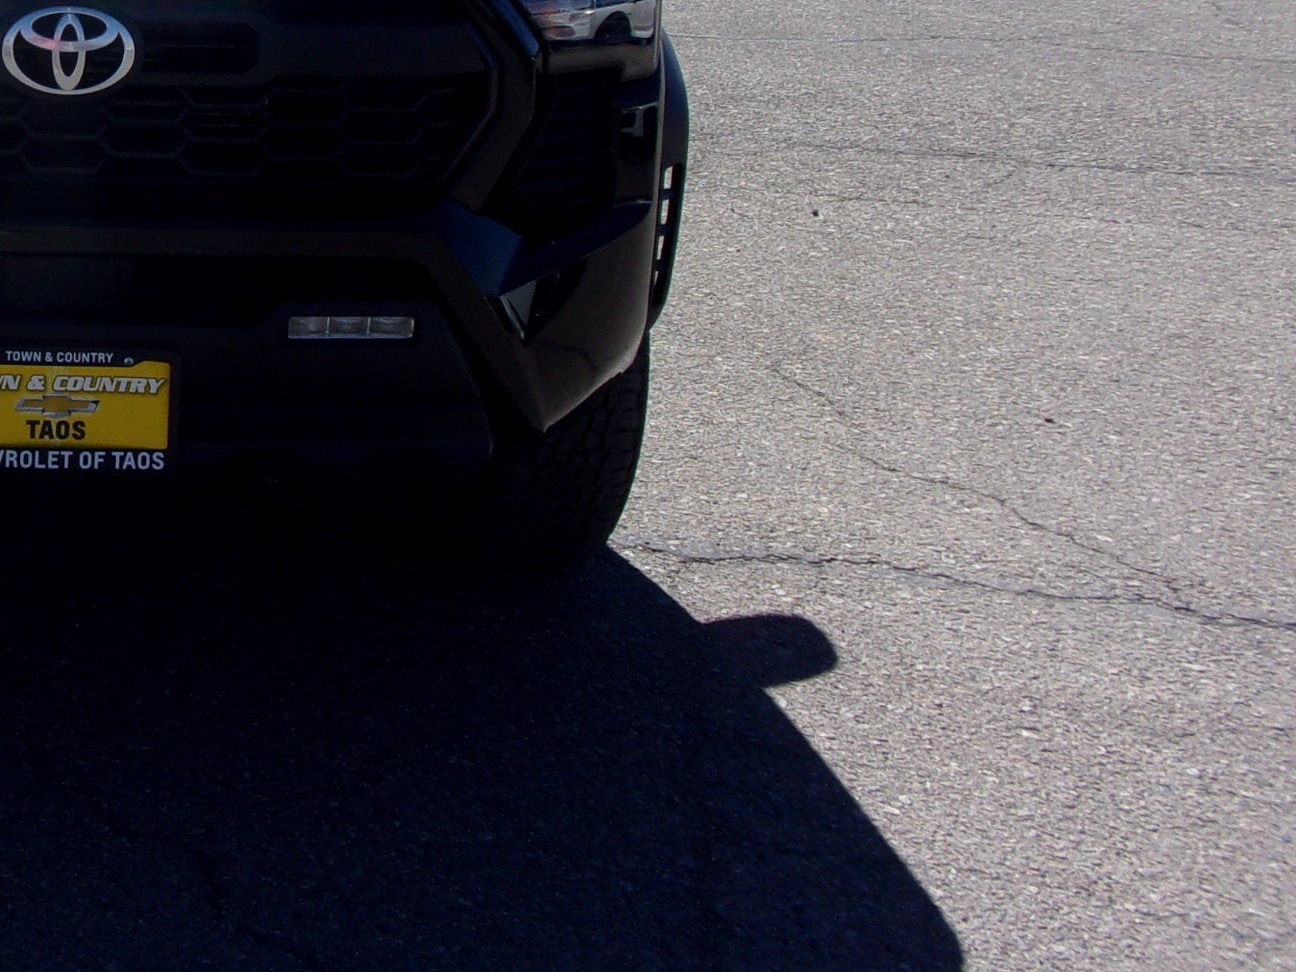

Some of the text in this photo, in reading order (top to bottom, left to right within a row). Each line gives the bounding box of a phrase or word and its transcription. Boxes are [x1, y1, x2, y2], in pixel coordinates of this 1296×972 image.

[6, 351, 114, 364] TOWN & COUNTRY
[27, 374, 46, 391] &
[52, 376, 165, 394] COUNTRY
[26, 420, 86, 440] TAOS
[78, 451, 105, 469] OF
[111, 452, 165, 470] TAOS
